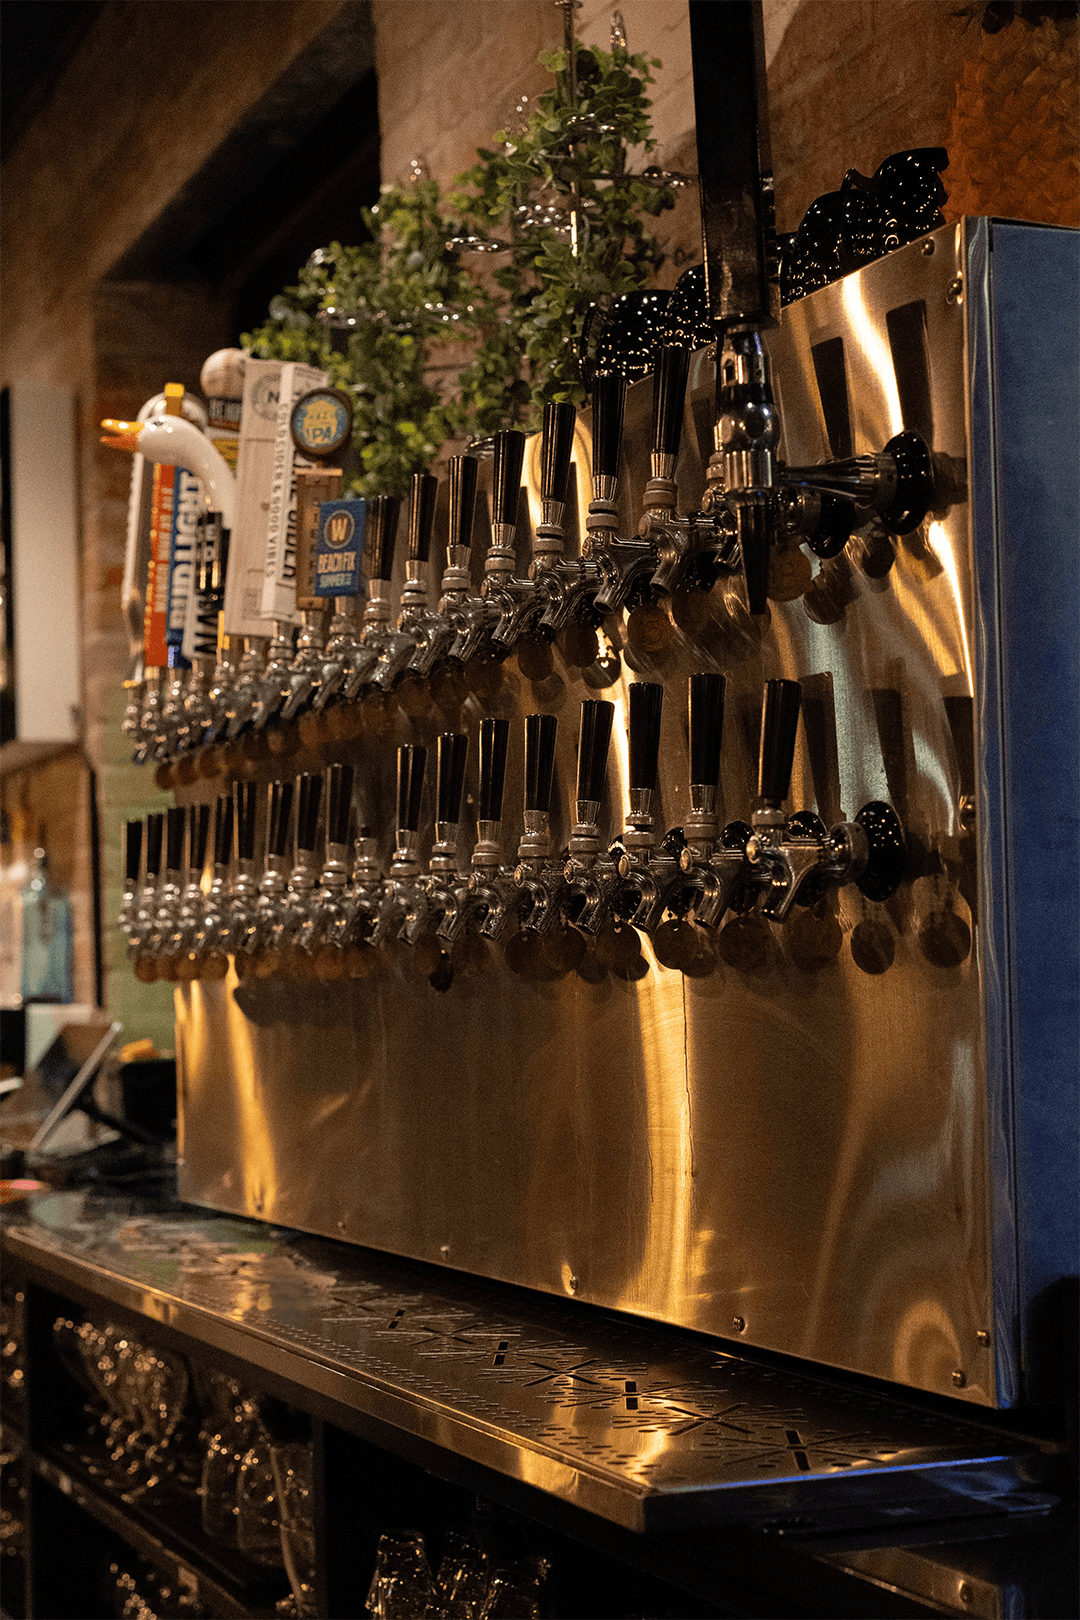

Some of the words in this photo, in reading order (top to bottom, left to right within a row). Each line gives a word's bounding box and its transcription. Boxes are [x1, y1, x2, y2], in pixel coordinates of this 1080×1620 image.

[305, 425, 332, 441] IPA
[274, 440, 286, 481] CIDER
[174, 471, 202, 562] LIGHT
[269, 497, 281, 532] GOOD
[331, 518, 348, 541] W
[264, 536, 279, 578] VIBES
[169, 563, 195, 630] BUD
